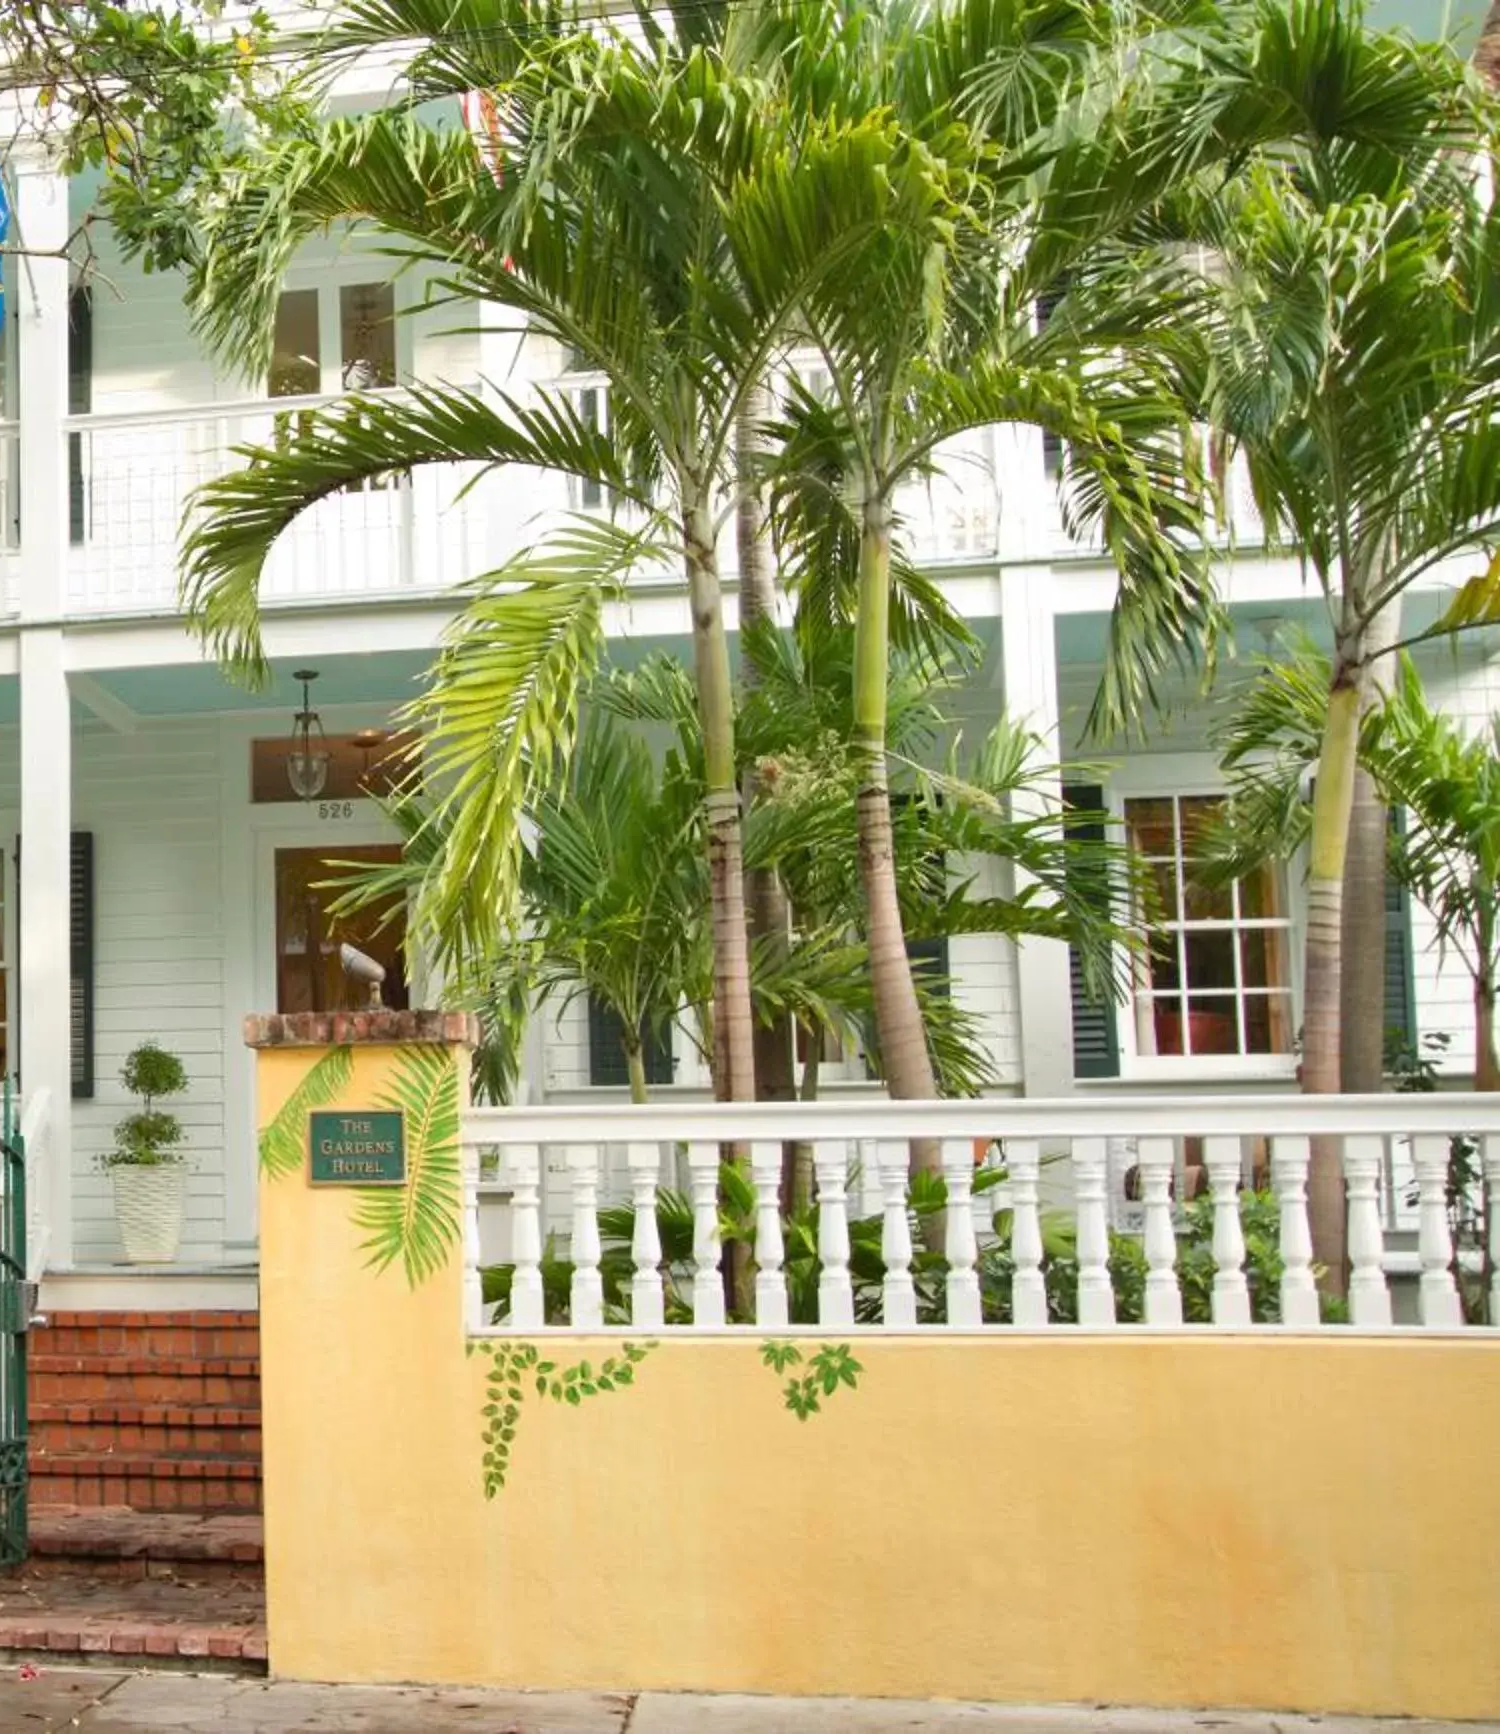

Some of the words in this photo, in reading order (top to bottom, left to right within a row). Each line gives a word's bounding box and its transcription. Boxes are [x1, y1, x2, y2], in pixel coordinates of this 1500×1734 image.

[318, 802, 354, 820] 526
[340, 1119, 372, 1134] THE
[320, 1139, 396, 1155] GARDENS
[332, 1159, 384, 1174] HOTEL
